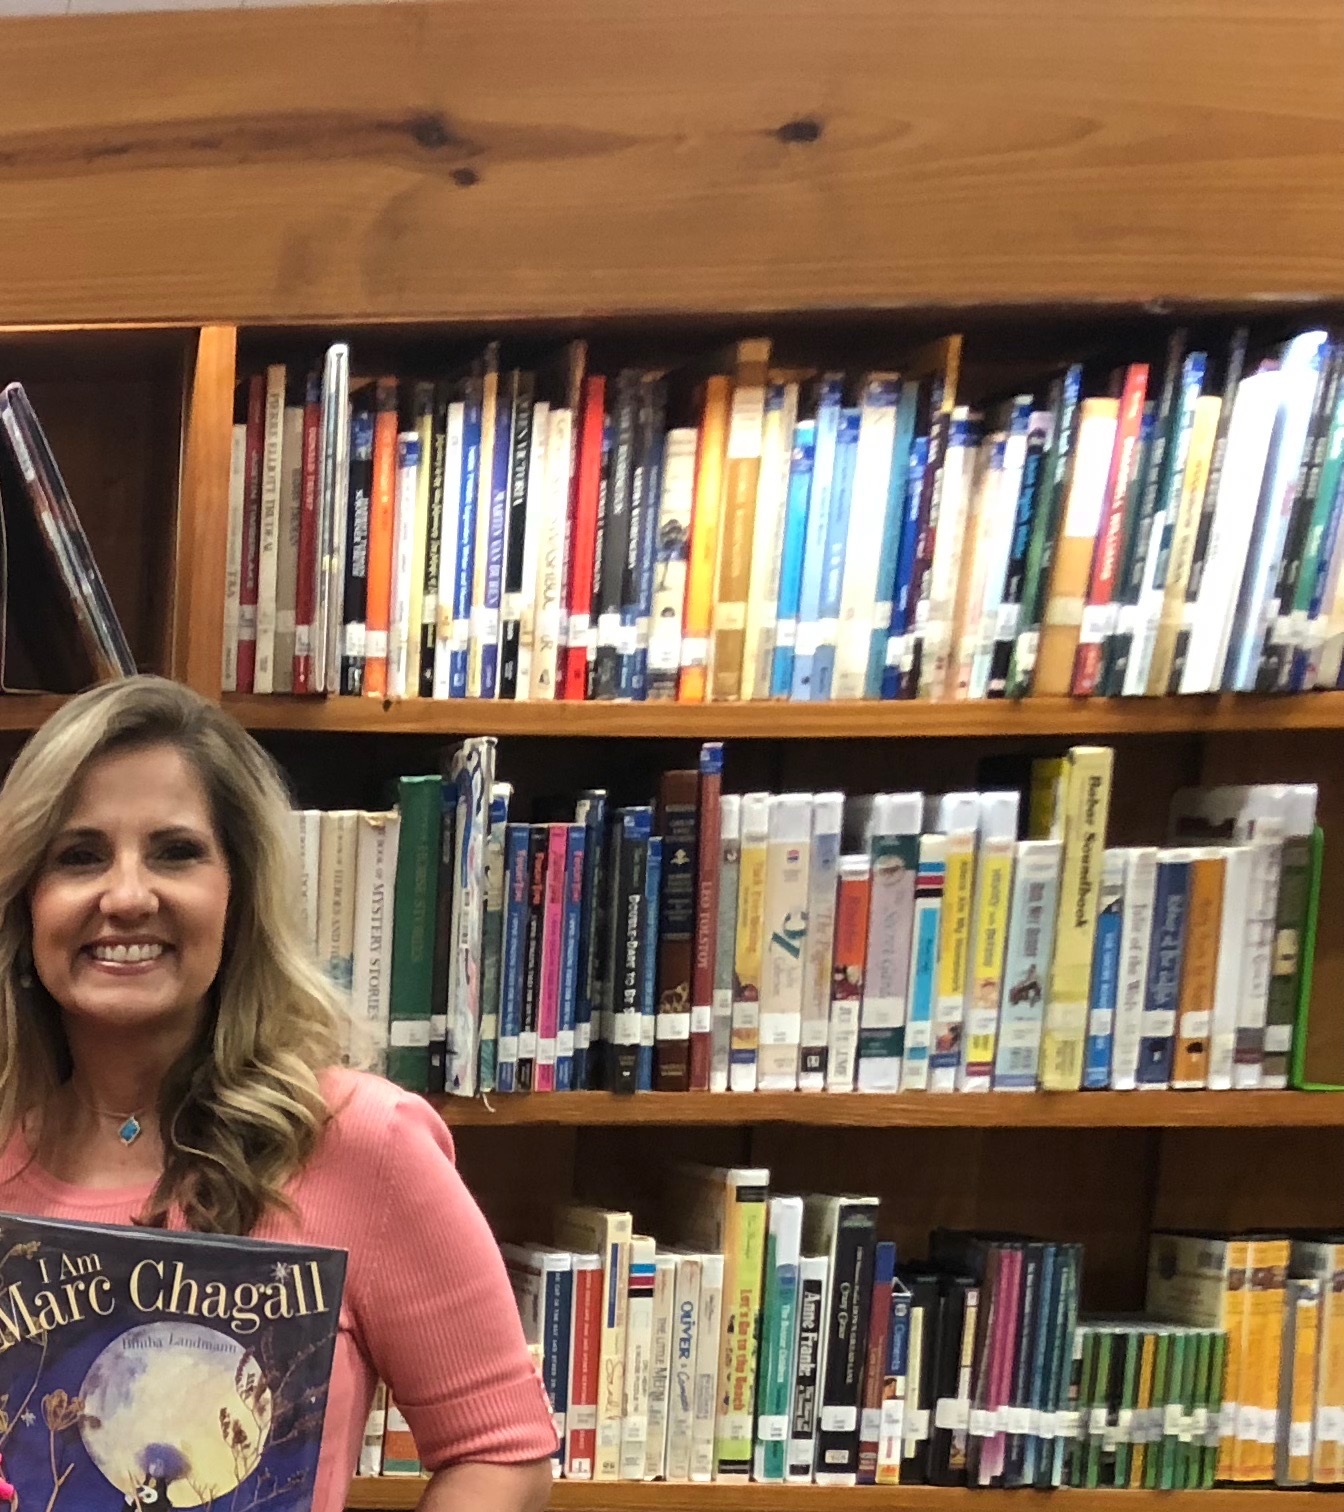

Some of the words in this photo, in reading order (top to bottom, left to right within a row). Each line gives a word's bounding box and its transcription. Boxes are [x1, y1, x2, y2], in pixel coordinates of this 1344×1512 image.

[700, 881, 712, 909] LEO
[1074, 833, 1096, 929] Soundbook
[369, 884, 384, 952] MYSTERY
[697, 913, 710, 969] TOLSTOY
[368, 959, 381, 1020] STORIES
[38, 1258, 50, 1284] I
[59, 1252, 103, 1280] Am
[129, 1260, 329, 1334] Chagall
[739, 1289, 752, 1318] Let's
[803, 1292, 820, 1329] Anne
[169, 1332, 237, 1354] Landmann
[737, 1339, 748, 1351] to
[736, 1354, 749, 1373] the
[733, 1375, 747, 1411] Beach
